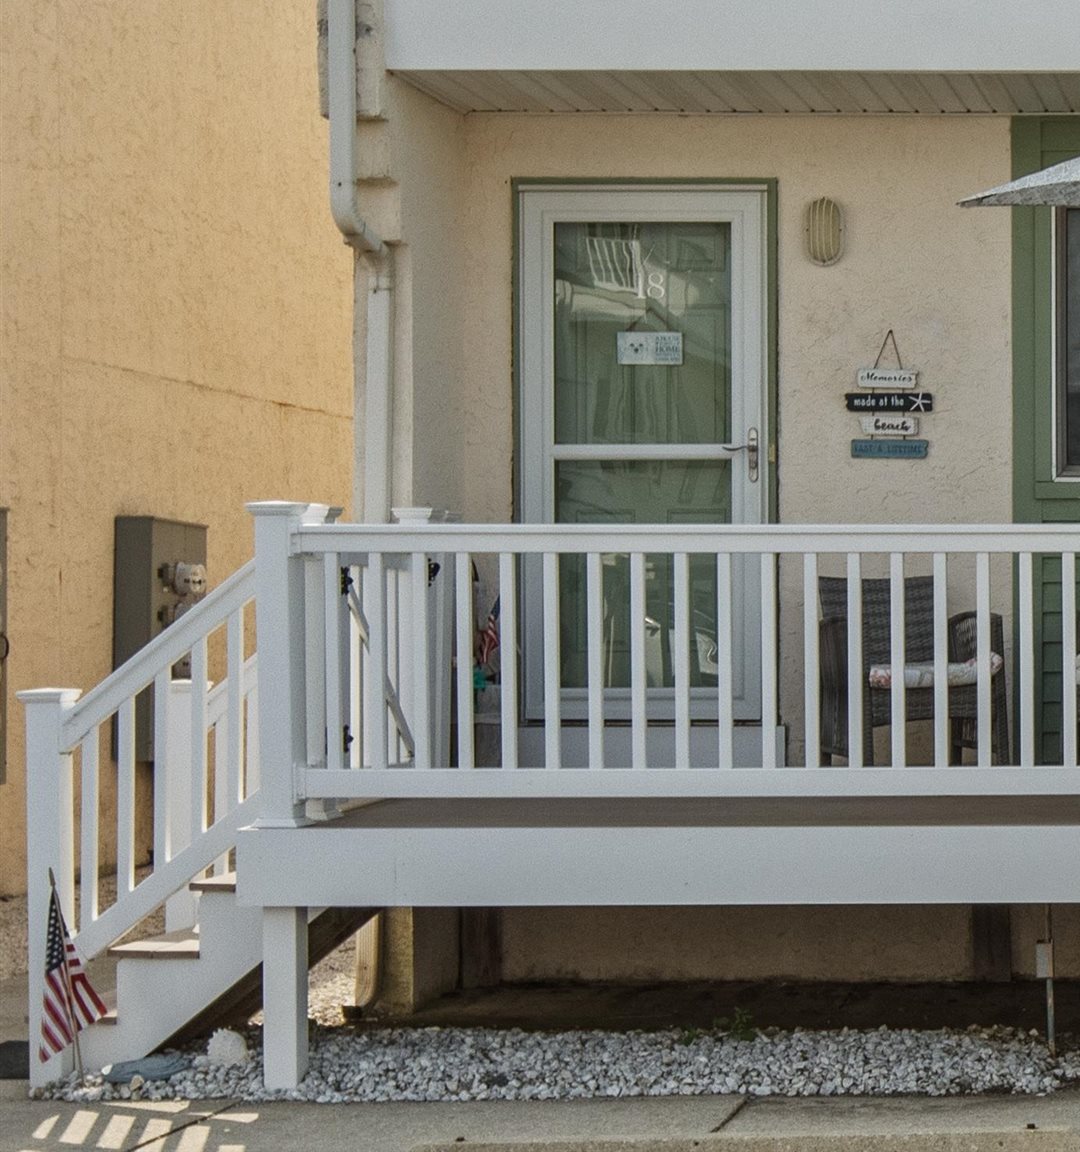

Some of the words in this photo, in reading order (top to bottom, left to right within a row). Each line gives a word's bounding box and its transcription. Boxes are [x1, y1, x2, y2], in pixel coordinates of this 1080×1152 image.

[637, 272, 665, 299] 18
[860, 372, 912, 383] Memories
[854, 395, 876, 406] made
[879, 395, 888, 406] at
[891, 395, 905, 406] the
[874, 418, 911, 431] beach
